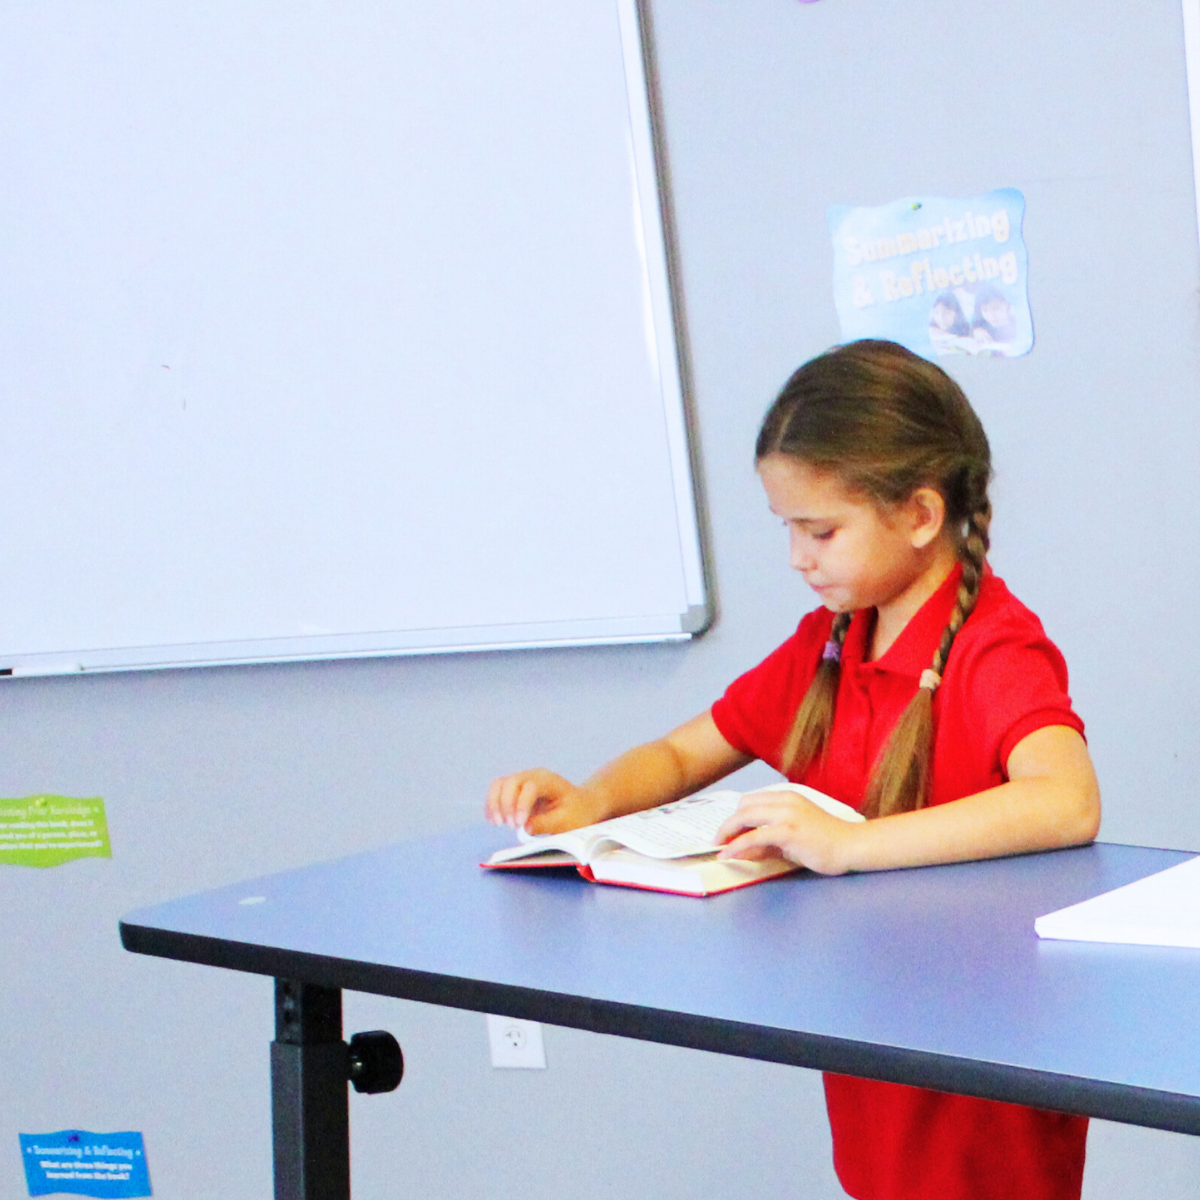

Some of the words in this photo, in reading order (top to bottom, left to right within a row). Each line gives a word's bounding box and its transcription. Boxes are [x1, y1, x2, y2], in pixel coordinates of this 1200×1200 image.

[842, 209, 1010, 267] Summarizing
[852, 275, 876, 308] &
[880, 250, 1018, 302] Reflecting
